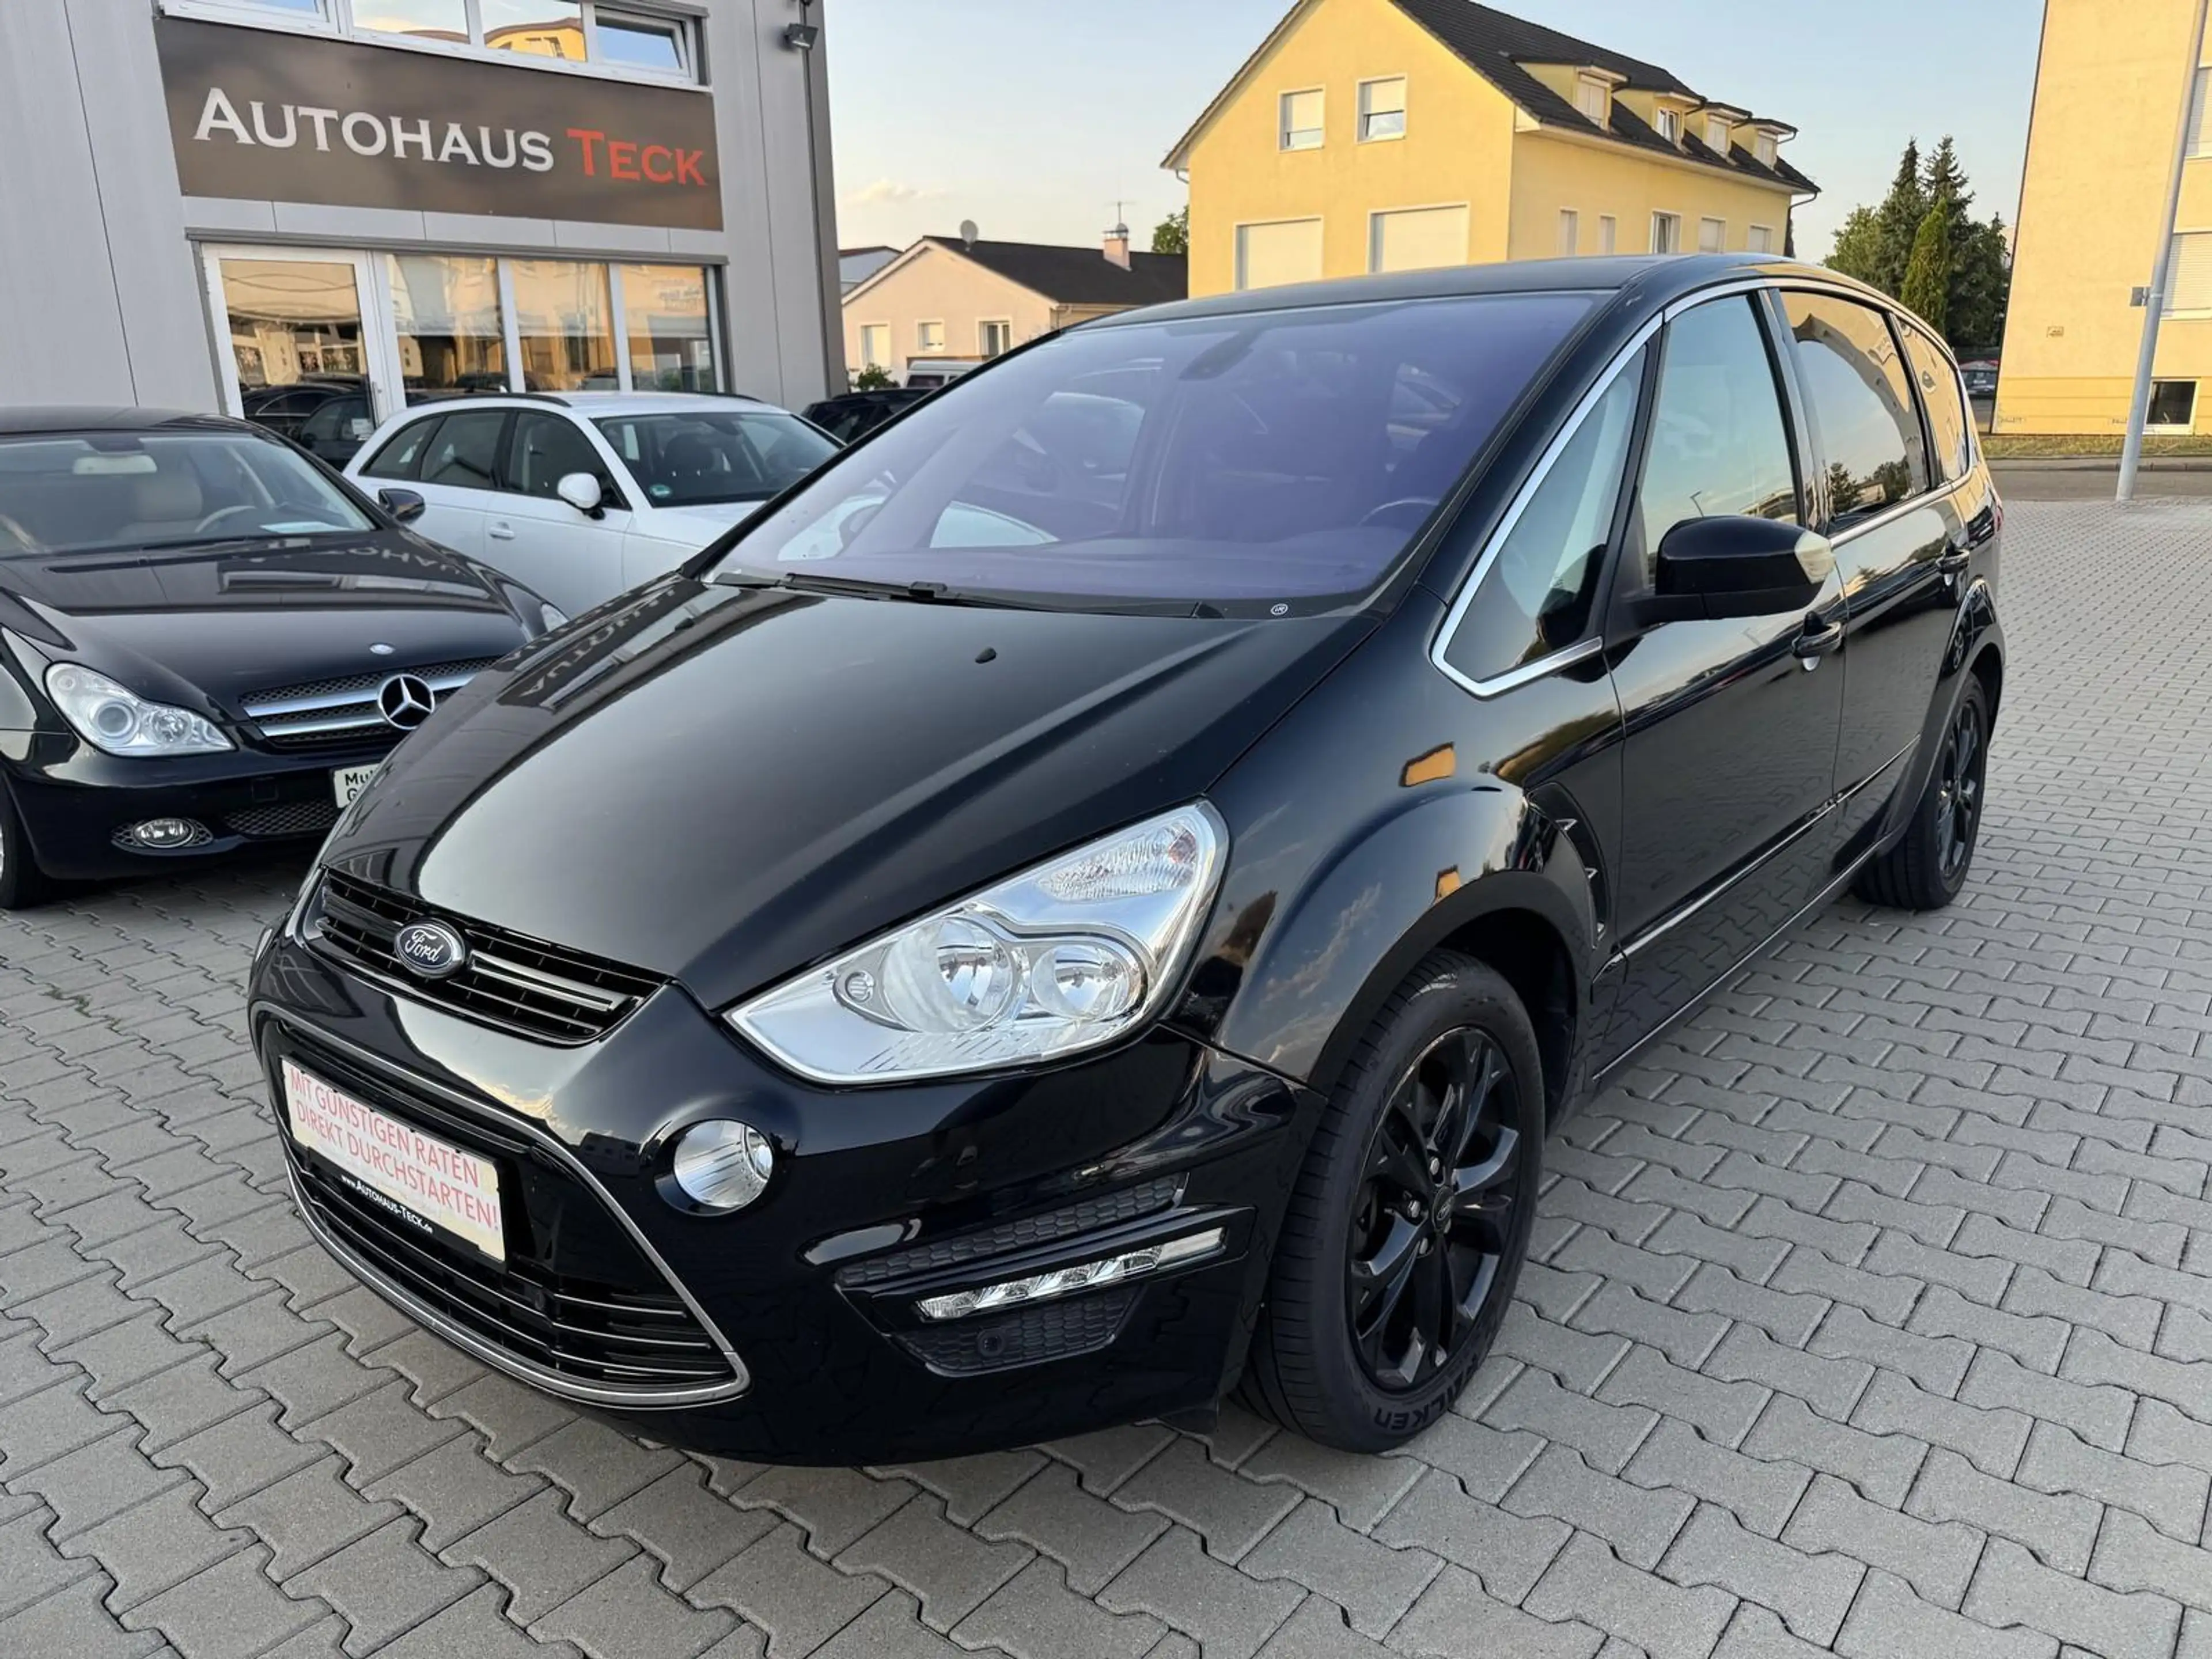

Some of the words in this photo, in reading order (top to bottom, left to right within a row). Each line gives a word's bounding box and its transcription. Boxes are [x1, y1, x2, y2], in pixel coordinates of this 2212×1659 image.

[193, 87, 555, 171] AUTOHAUS
[567, 128, 709, 187] TECK
[404, 929, 444, 963] Ford
[296, 1100, 343, 1148] DIREKT
[347, 1131, 499, 1231] DURCHSTARTEN!
[415, 1137, 479, 1188] RATEN
